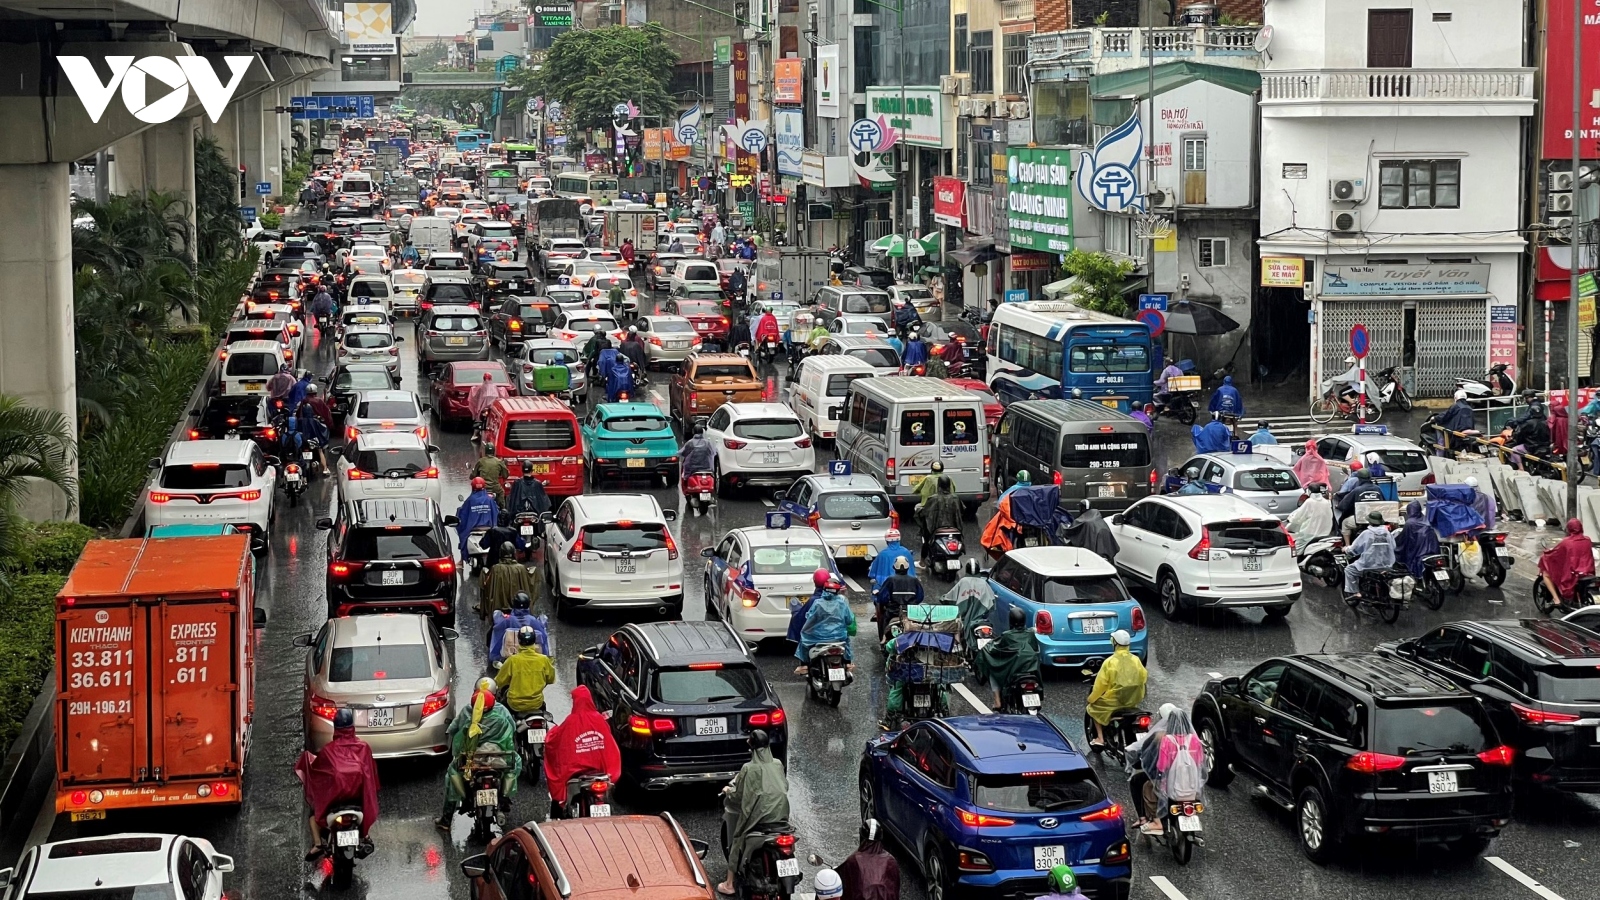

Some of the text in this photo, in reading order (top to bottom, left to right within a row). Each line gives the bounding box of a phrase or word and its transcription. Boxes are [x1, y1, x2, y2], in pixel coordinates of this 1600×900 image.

[1162, 109, 1172, 120] BIA
[1019, 162, 1035, 185] CHỢ
[1035, 156, 1049, 184] HẢI
[1050, 156, 1067, 185] SẢN
[1010, 186, 1067, 218] QUẢNG NINH
[1384, 266, 1470, 280] Tuyết Vân
[1492, 348, 1512, 357] XE
[1238, 442, 1248, 452] G7
[835, 462, 846, 473] G7
[170, 622, 217, 640] EXPRESS
[71, 646, 209, 668] 33.811 .811
[71, 667, 207, 688] 36.611 .611
[70, 700, 131, 715] 29H-196.21
[1436, 773, 1450, 782] 29A
[1431, 782, 1456, 792] 390.27
[1042, 847, 1057, 858] 30F
